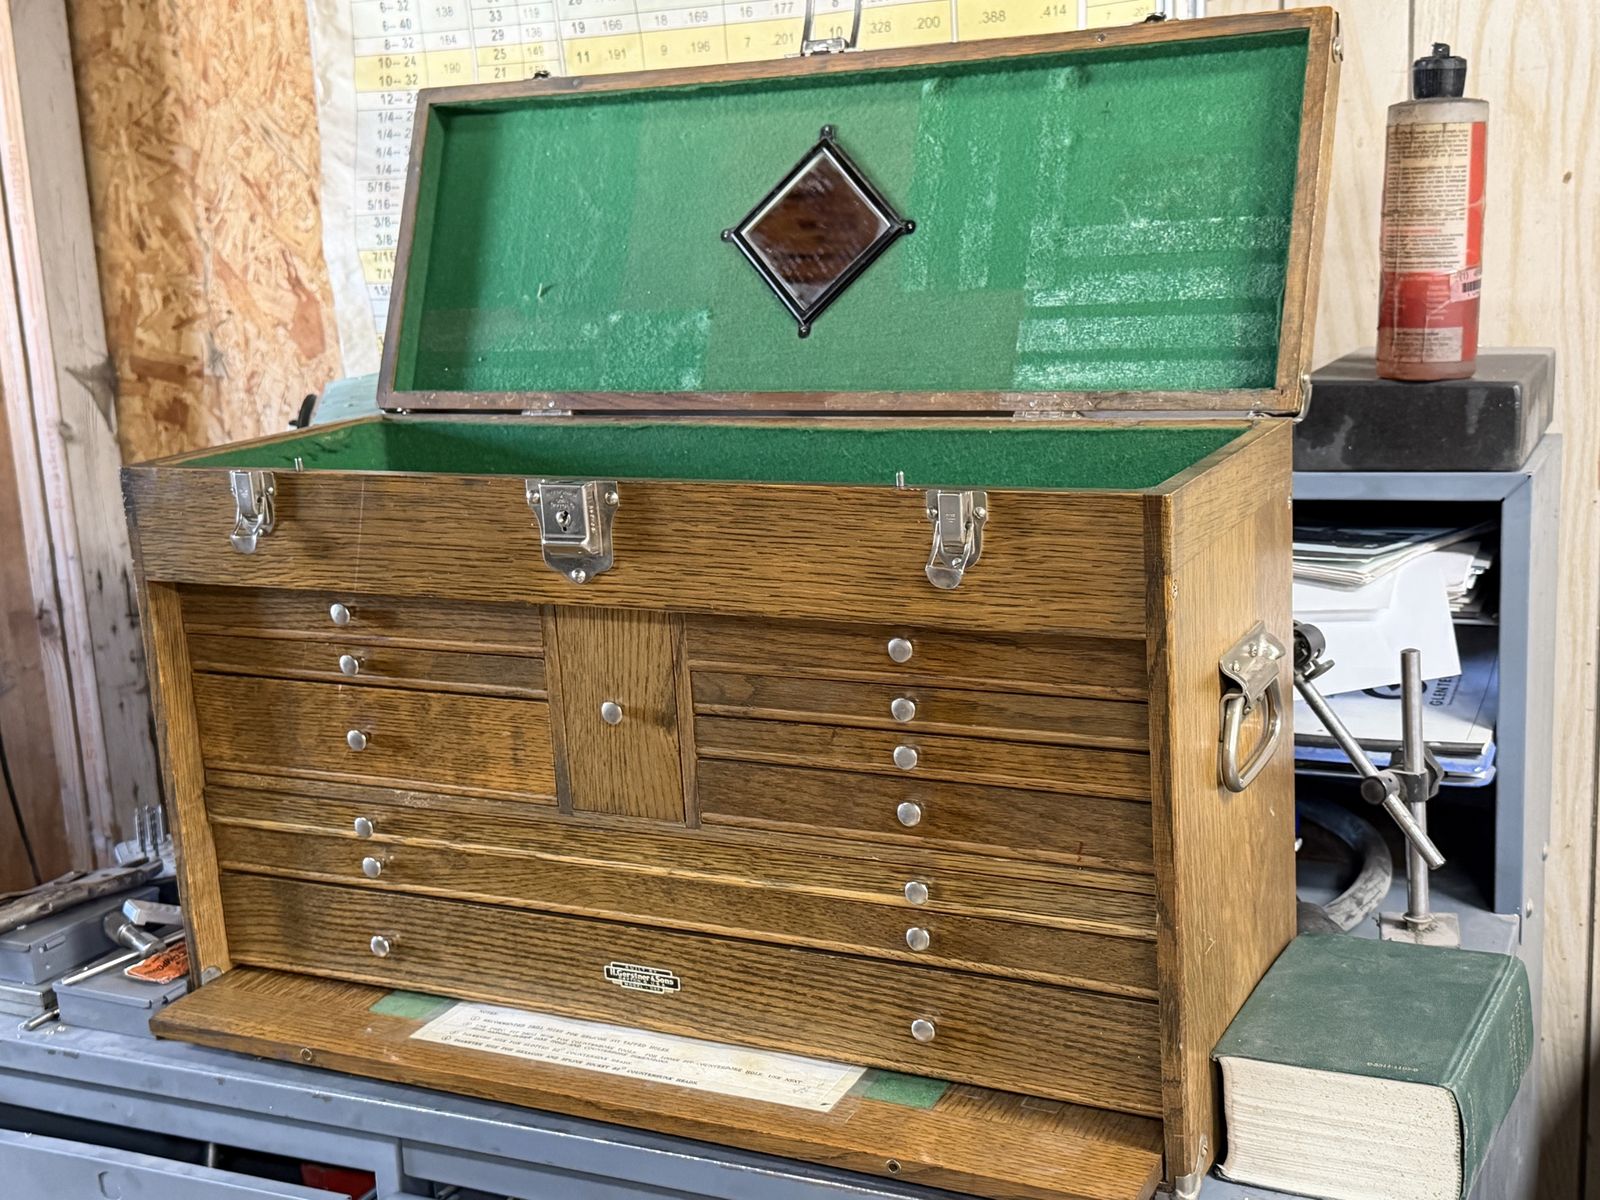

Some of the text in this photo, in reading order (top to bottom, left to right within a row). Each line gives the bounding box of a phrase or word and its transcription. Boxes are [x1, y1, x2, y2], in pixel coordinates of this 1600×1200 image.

[489, 10, 502, 22] 33
[740, 6, 753, 18] 16
[1040, 4, 1066, 19] .414
[655, 15, 668, 26] 18
[572, 22, 586, 34] 19
[491, 30, 504, 42] 29
[744, 37, 751, 48] 7
[494, 48, 506, 60] 25
[660, 45, 668, 56] 9
[577, 51, 590, 63] 11
[494, 68, 506, 79] 21
[1429, 676, 1452, 706] GLENTE
[617, 969, 650, 982] Gerstner
[654, 976, 674, 986] Sons
